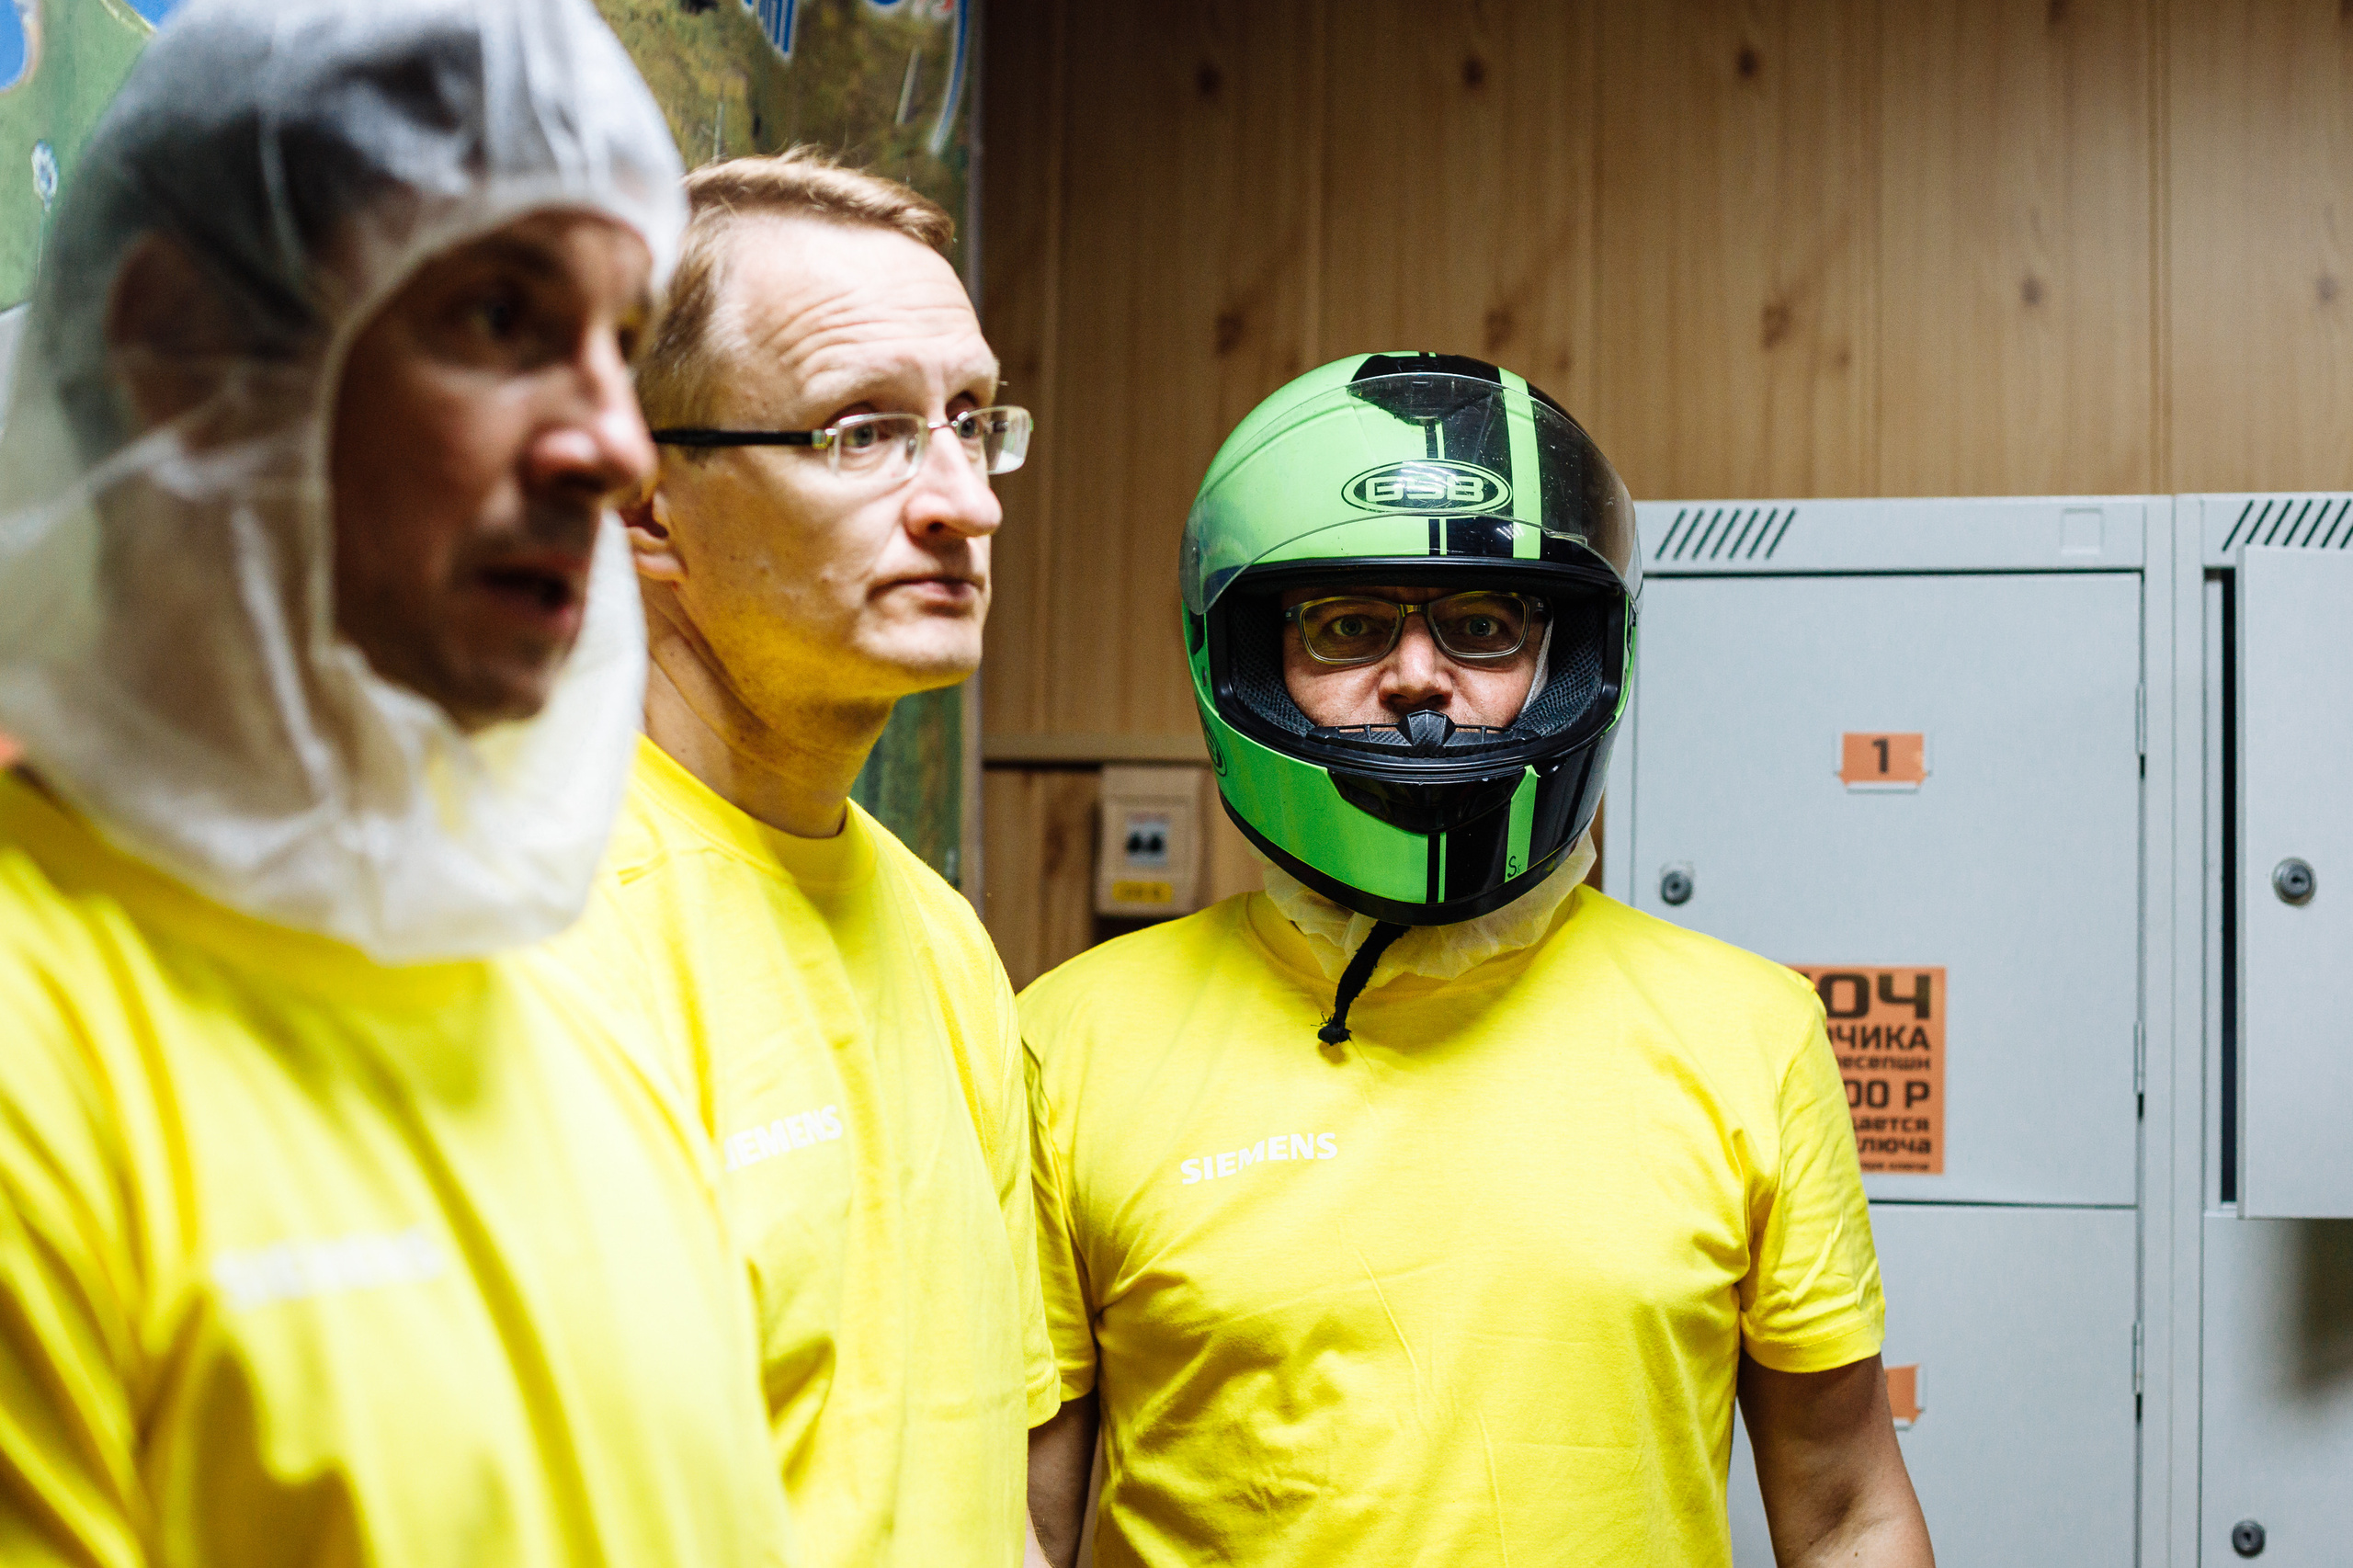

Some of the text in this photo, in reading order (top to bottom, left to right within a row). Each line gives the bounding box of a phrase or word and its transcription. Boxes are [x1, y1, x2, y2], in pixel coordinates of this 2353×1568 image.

[1365, 475, 1484, 503] GSB
[1871, 738, 1889, 773] 1
[1827, 1025, 1930, 1051] ЧИКА
[723, 1104, 843, 1173] IEMENS
[1857, 1138, 1930, 1153] люча
[1180, 1131, 1338, 1185] SIEMENS
